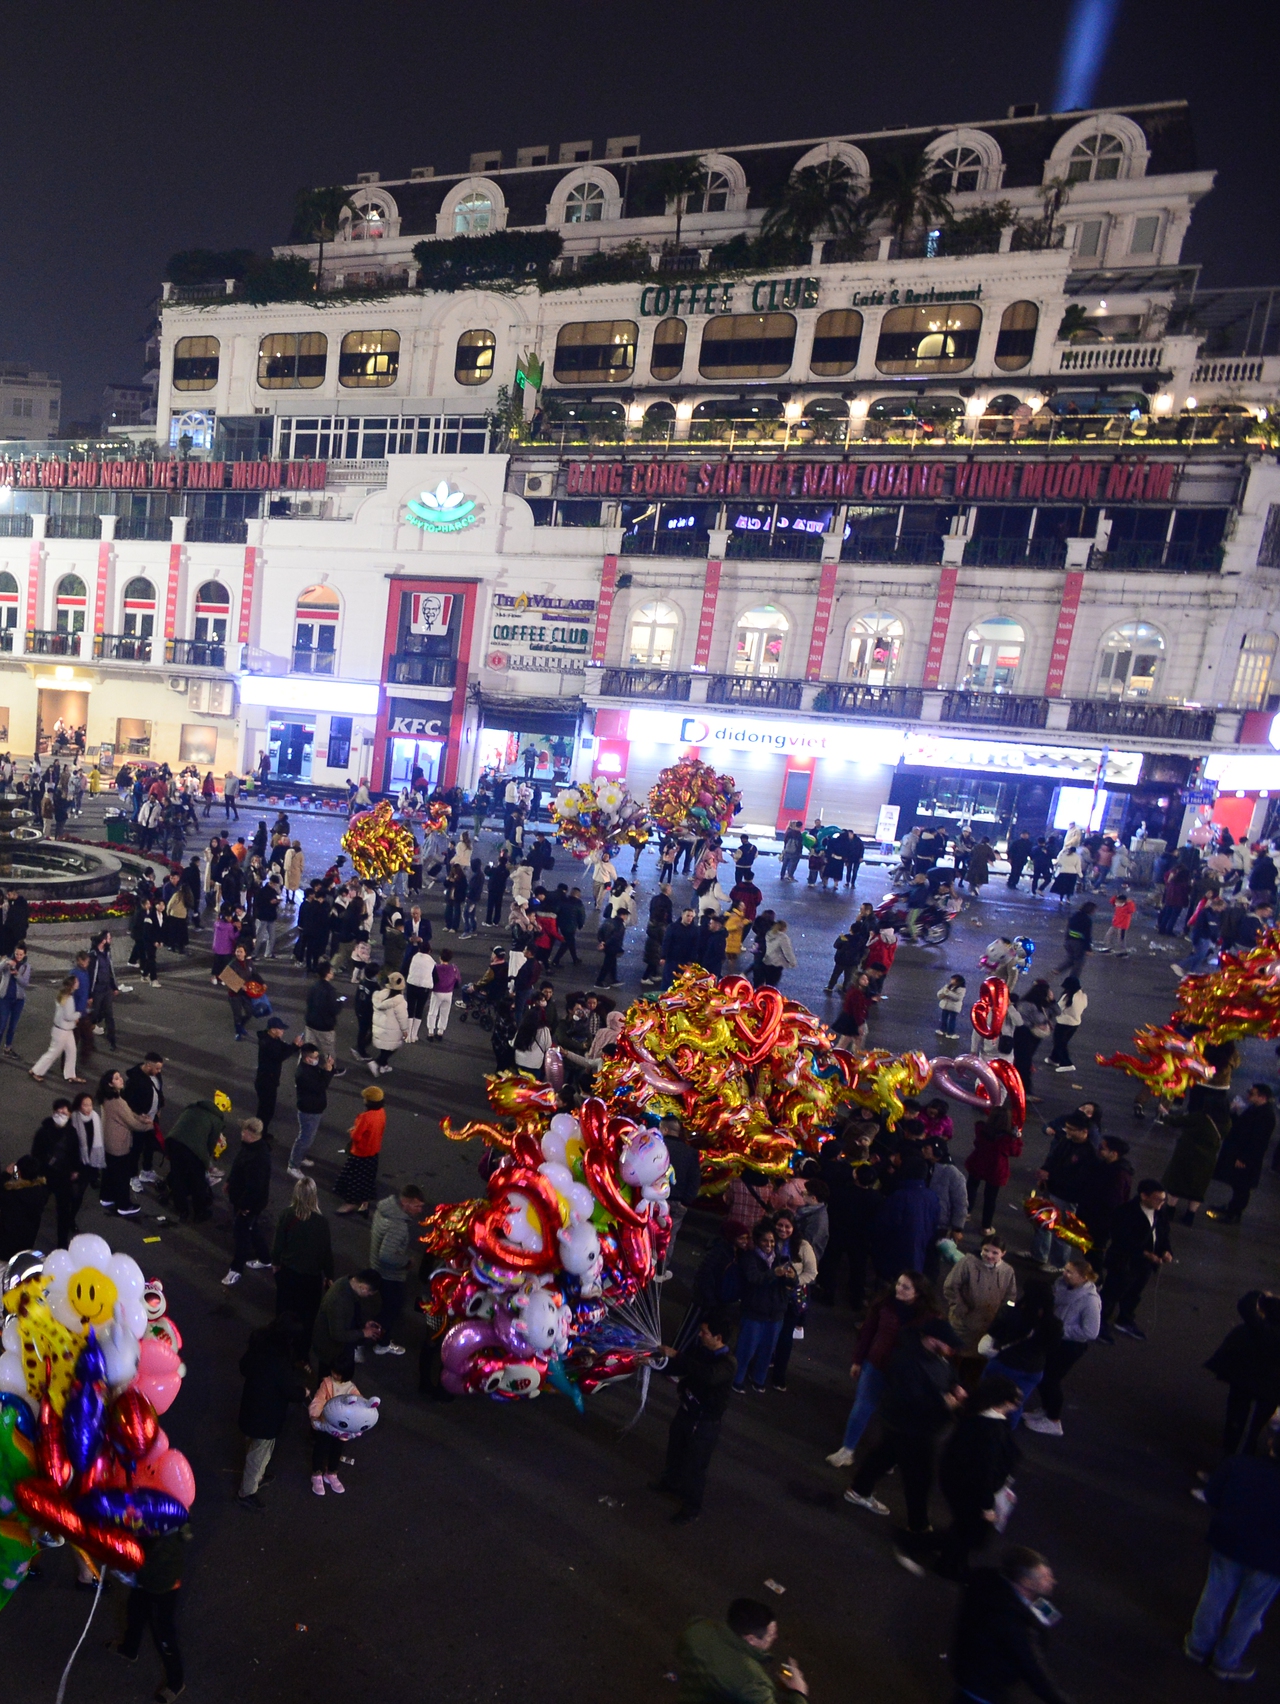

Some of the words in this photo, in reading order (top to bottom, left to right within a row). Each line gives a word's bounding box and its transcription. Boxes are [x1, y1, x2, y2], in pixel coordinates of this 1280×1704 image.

[639, 282, 736, 317] COFFEE
[752, 276, 820, 312] CLUB
[852, 289, 887, 307] Café
[890, 289, 901, 304] &
[905, 283, 982, 304] Restaurant
[41, 455, 65, 491] HỘI
[67, 453, 97, 487] CHỦ
[101, 455, 147, 488] NGHĨA
[152, 454, 184, 493] VIỆT
[187, 461, 224, 489] NAM
[232, 454, 281, 489] MUÔN
[287, 454, 327, 490] NĂM
[631, 453, 689, 501] CỘNG
[697, 453, 742, 496] SẢN
[749, 453, 797, 501] VIỆT
[800, 463, 858, 497] NAM
[861, 463, 946, 500] QUANG
[955, 463, 1015, 498] VINH
[1019, 454, 1102, 500] MUÔN
[1105, 454, 1175, 501] NĂM
[405, 513, 477, 533] PHYTOPHARCO
[493, 624, 546, 642] COFFEE
[551, 627, 589, 644] CLUB
[510, 655, 584, 670] MANWAH
[1049, 668, 1063, 676] 2024
[390, 717, 443, 736] KFC
[714, 726, 828, 750] didongviet
